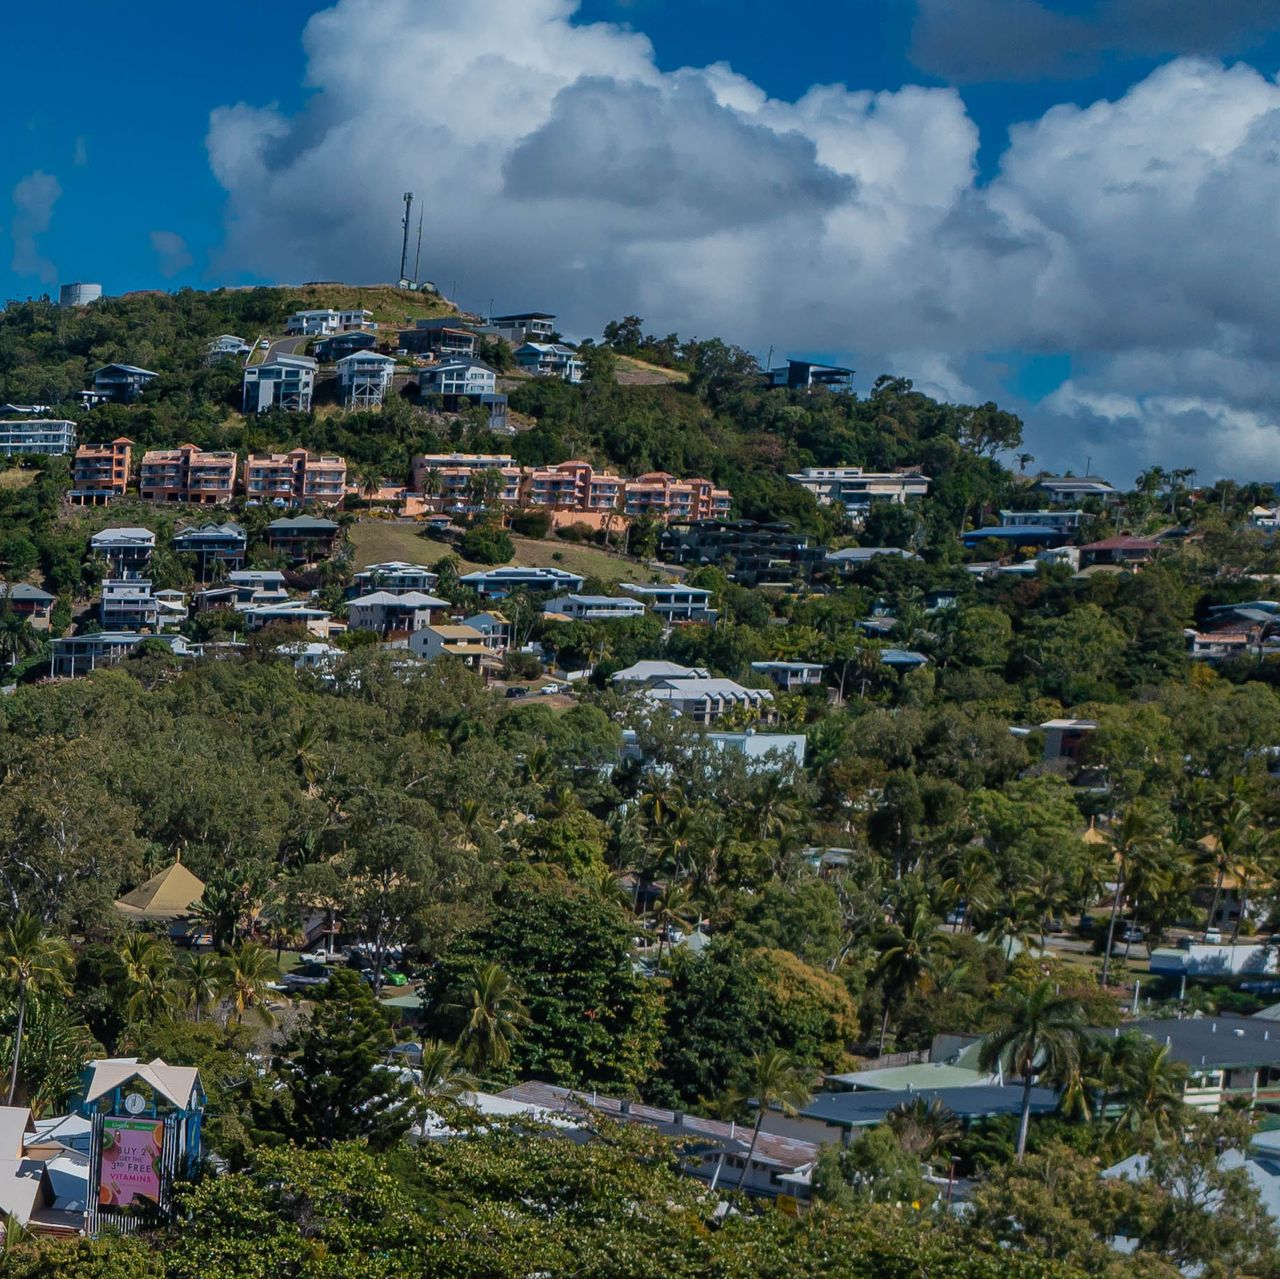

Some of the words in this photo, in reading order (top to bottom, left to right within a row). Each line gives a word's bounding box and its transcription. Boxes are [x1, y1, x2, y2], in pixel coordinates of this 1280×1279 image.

[117, 1146, 137, 1155] BUY
[141, 1148, 147, 1156] 2
[127, 1163, 151, 1173] FREE
[110, 1173, 152, 1184] VITAMINS
